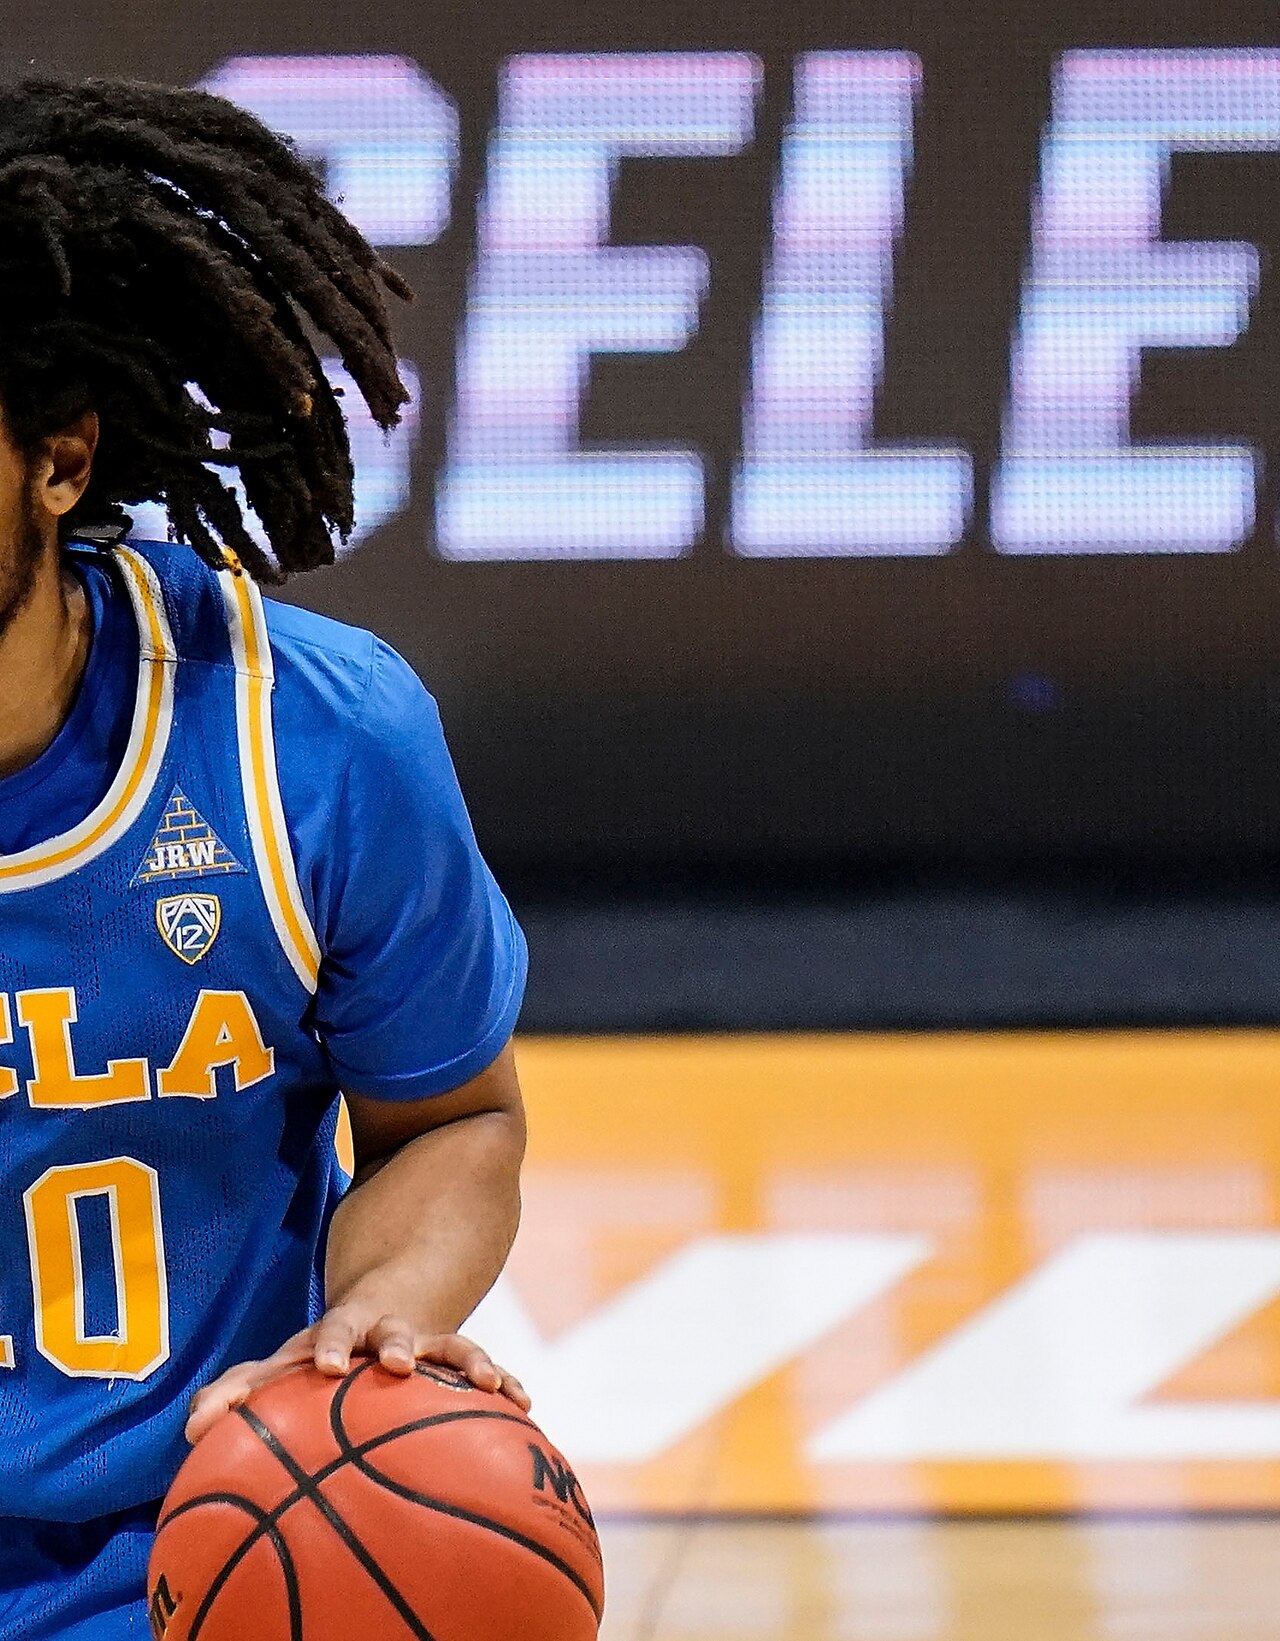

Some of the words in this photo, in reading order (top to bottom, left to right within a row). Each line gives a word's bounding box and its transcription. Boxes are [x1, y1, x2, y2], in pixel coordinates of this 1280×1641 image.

[150, 841, 217, 871] JRW
[161, 898, 216, 938] PAC
[175, 924, 206, 951] 12
